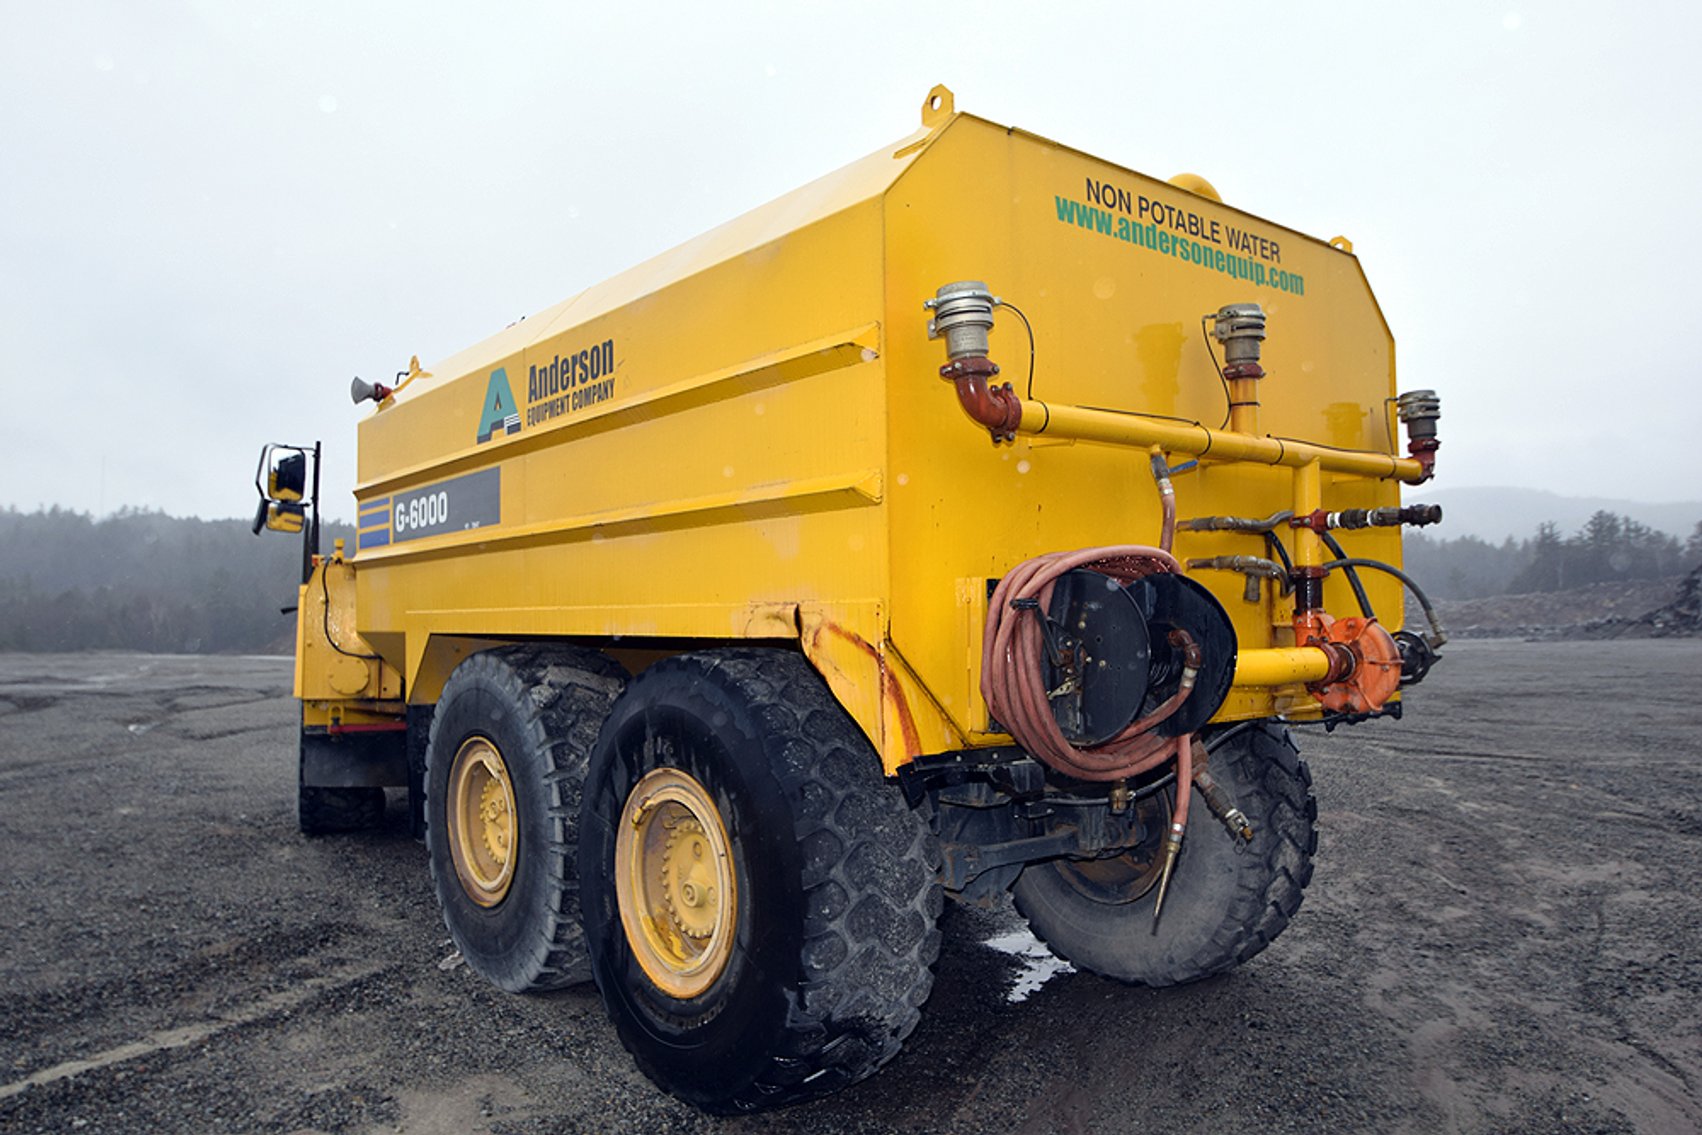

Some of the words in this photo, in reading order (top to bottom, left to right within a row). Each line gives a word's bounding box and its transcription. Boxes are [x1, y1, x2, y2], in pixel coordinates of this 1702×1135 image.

[1054, 195, 1305, 296] www.andersonequip.com
[1086, 177, 1132, 215] NON
[1138, 195, 1221, 244] POTABLE
[1225, 225, 1281, 263] WATER
[527, 394, 570, 427] EQUIPMENT
[572, 378, 615, 411] COMPANY
[528, 339, 614, 404] Anderson
[395, 491, 448, 533] G-6000
